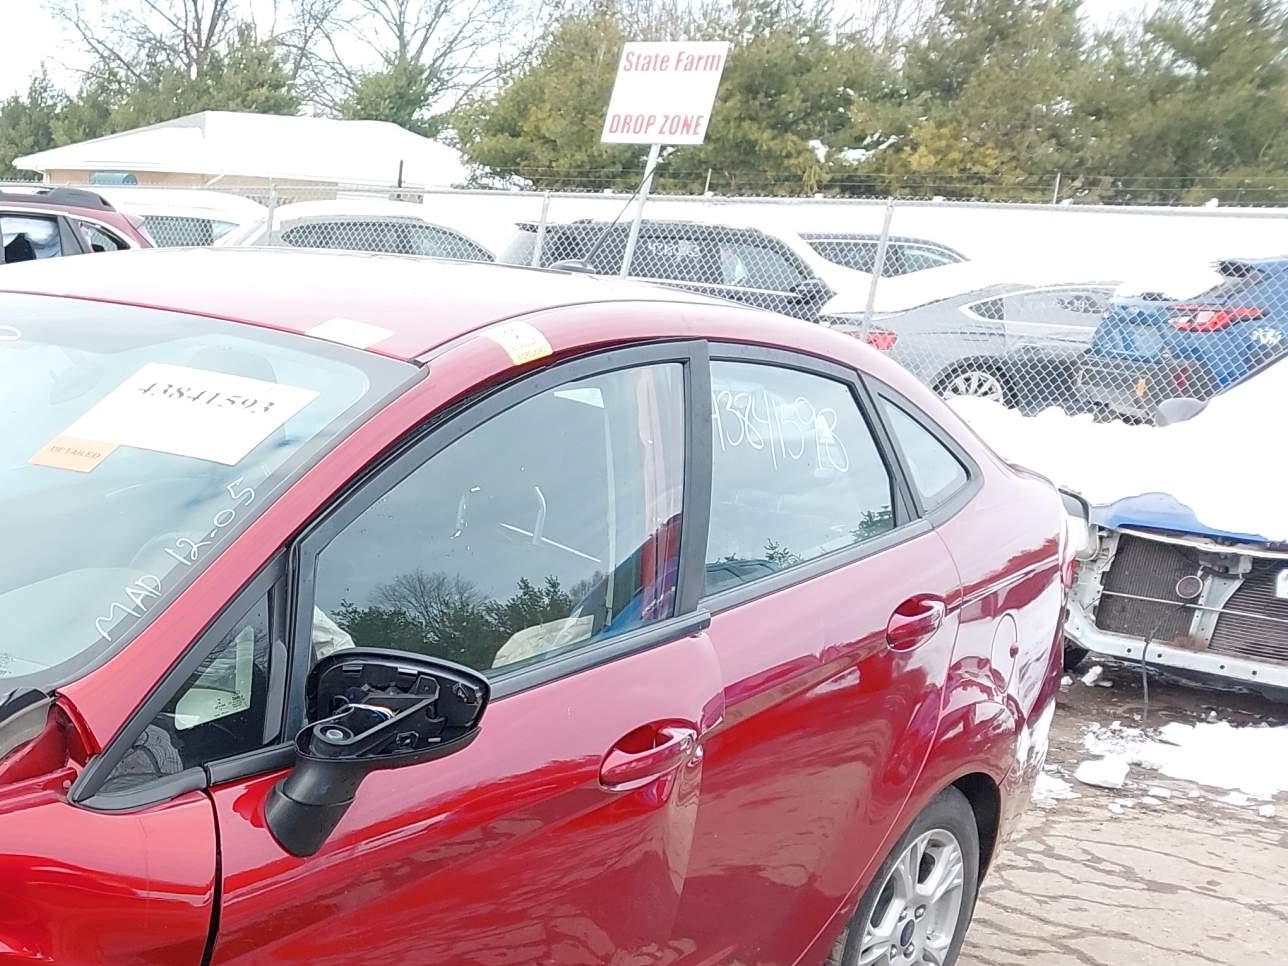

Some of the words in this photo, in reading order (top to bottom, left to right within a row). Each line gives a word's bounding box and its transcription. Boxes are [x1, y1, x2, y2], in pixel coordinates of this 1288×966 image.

[623, 51, 671, 72] State
[674, 51, 722, 72] Farm
[608, 114, 656, 135] DROP
[658, 114, 704, 136] ZONE
[138, 382, 275, 413] 43841593
[48, 445, 102, 460] DETAILED
[95, 574, 162, 642] MAD
